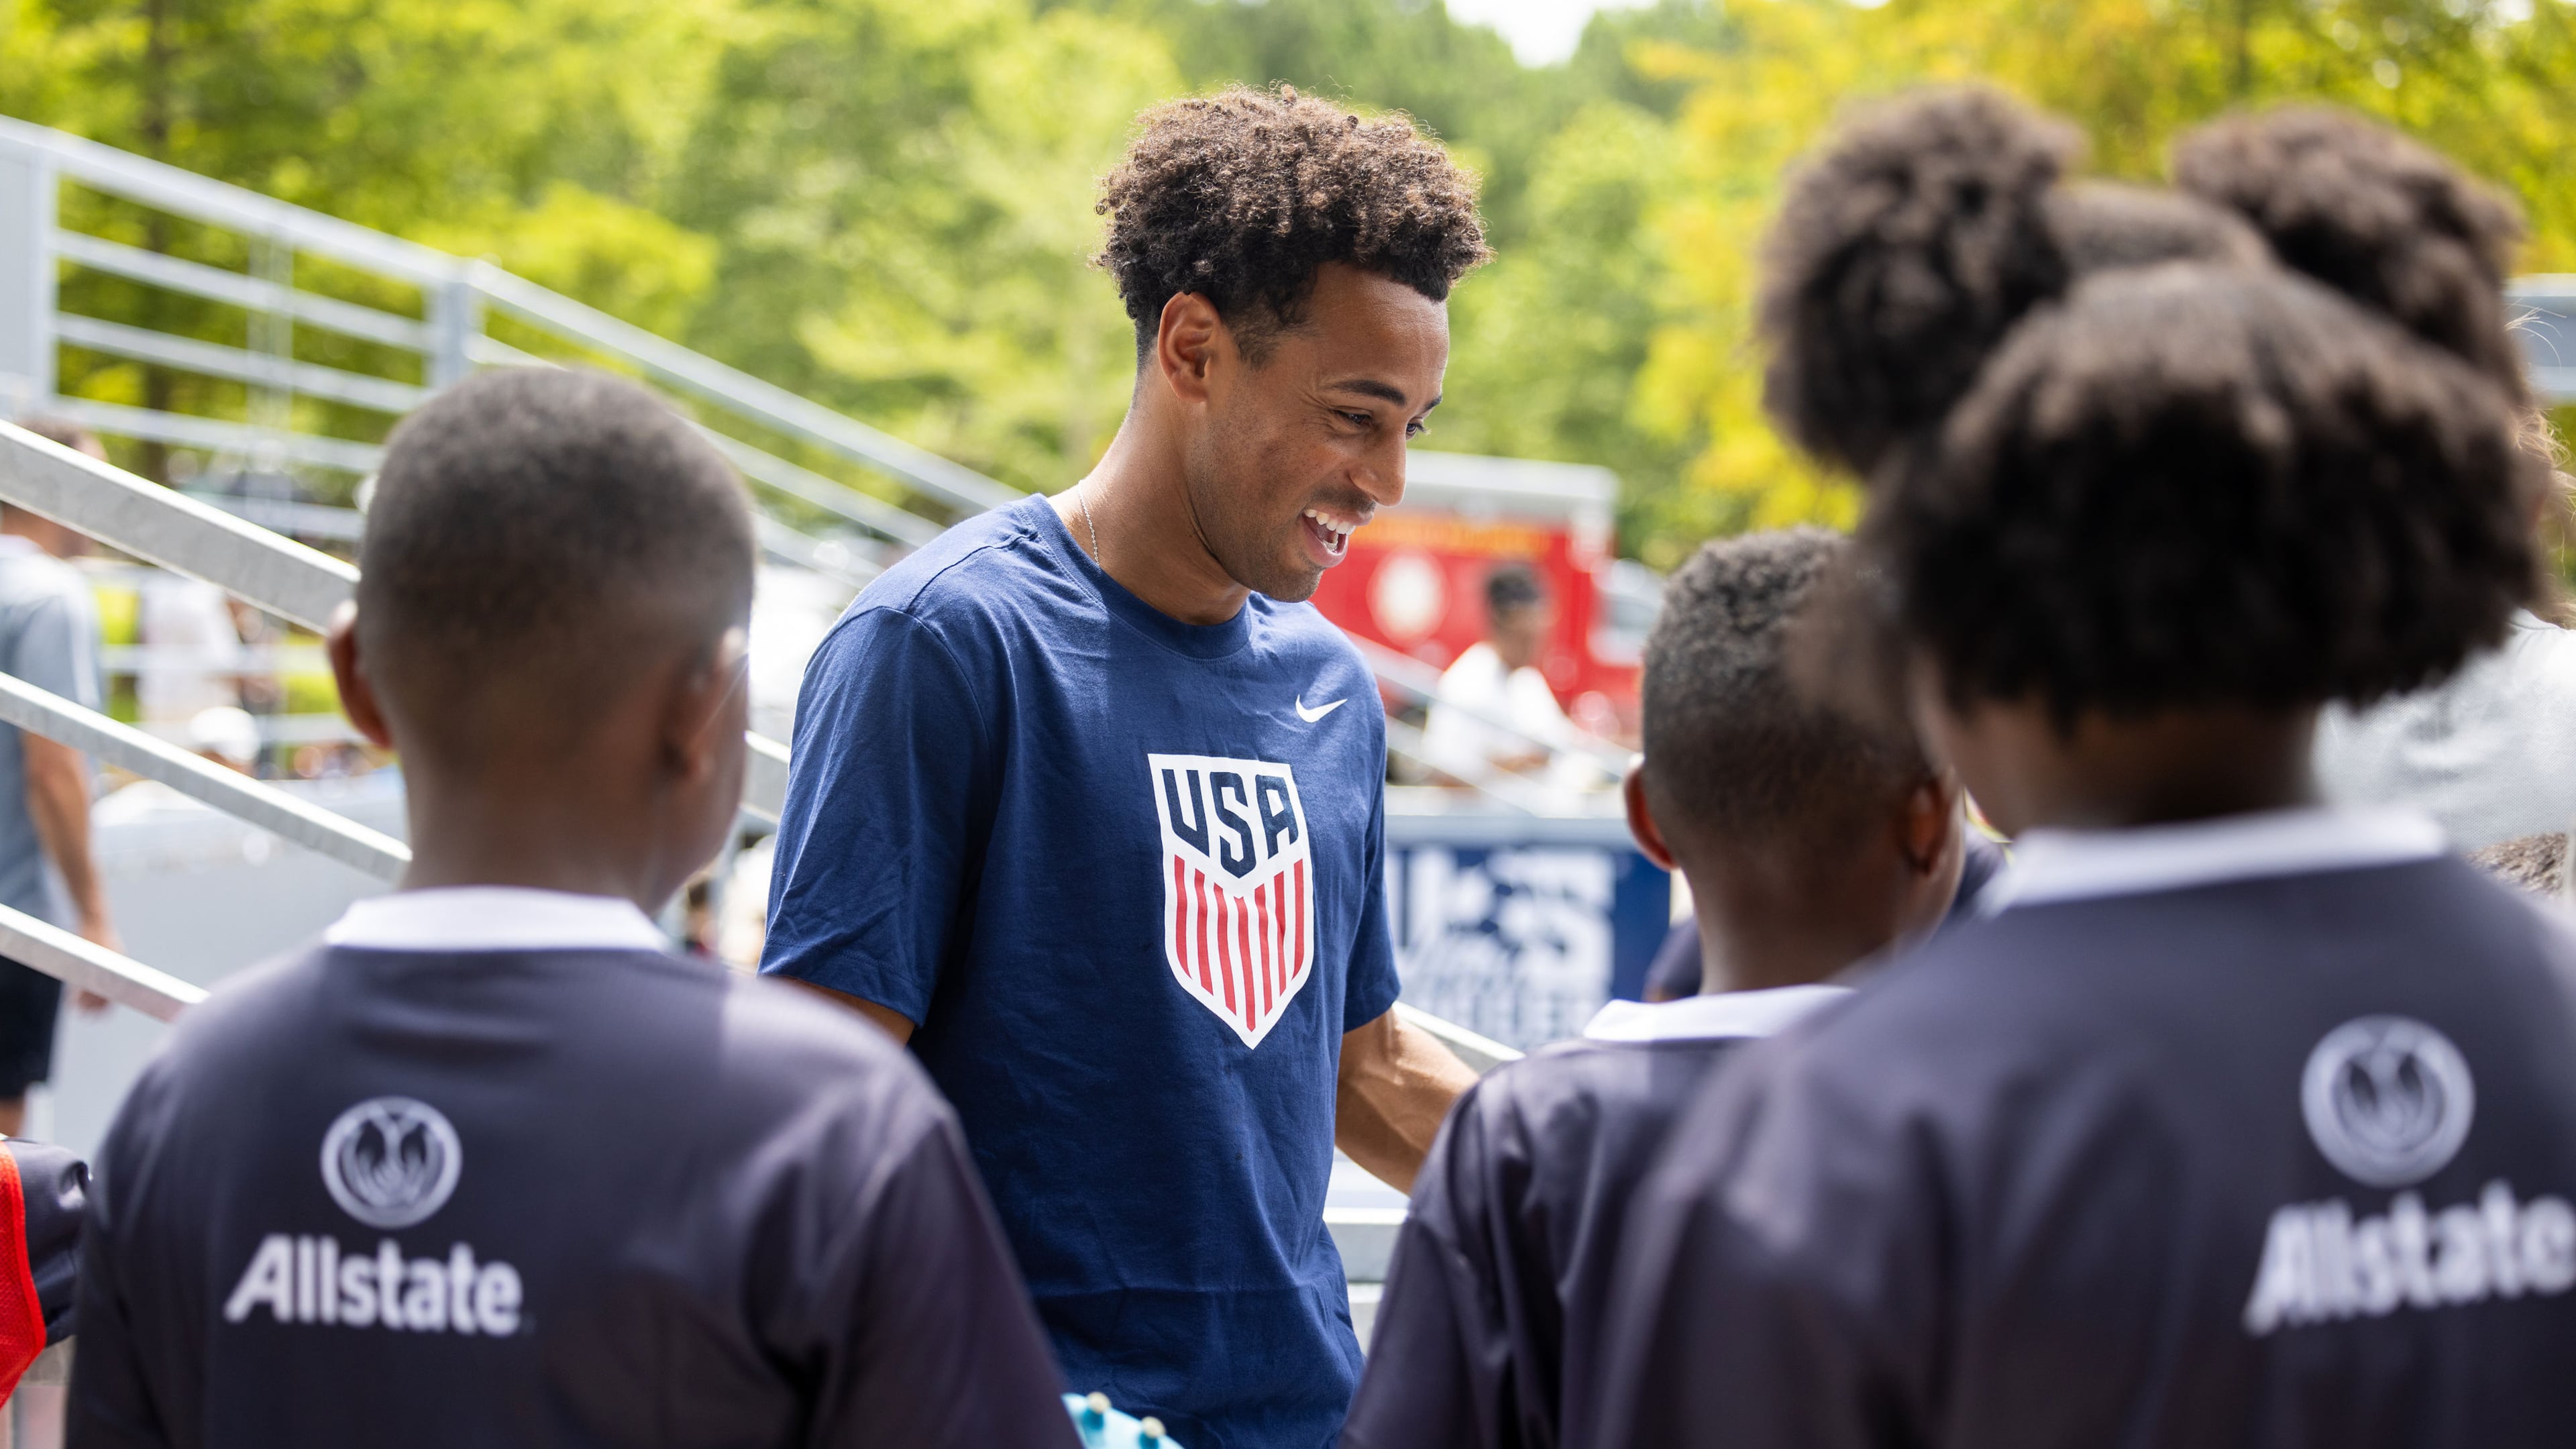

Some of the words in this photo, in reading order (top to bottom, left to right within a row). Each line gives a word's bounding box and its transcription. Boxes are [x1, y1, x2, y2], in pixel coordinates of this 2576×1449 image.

[1161, 769, 1299, 879] USA
[224, 1233, 523, 1336] Allstate
[2243, 1179, 2576, 1335] Allstate
